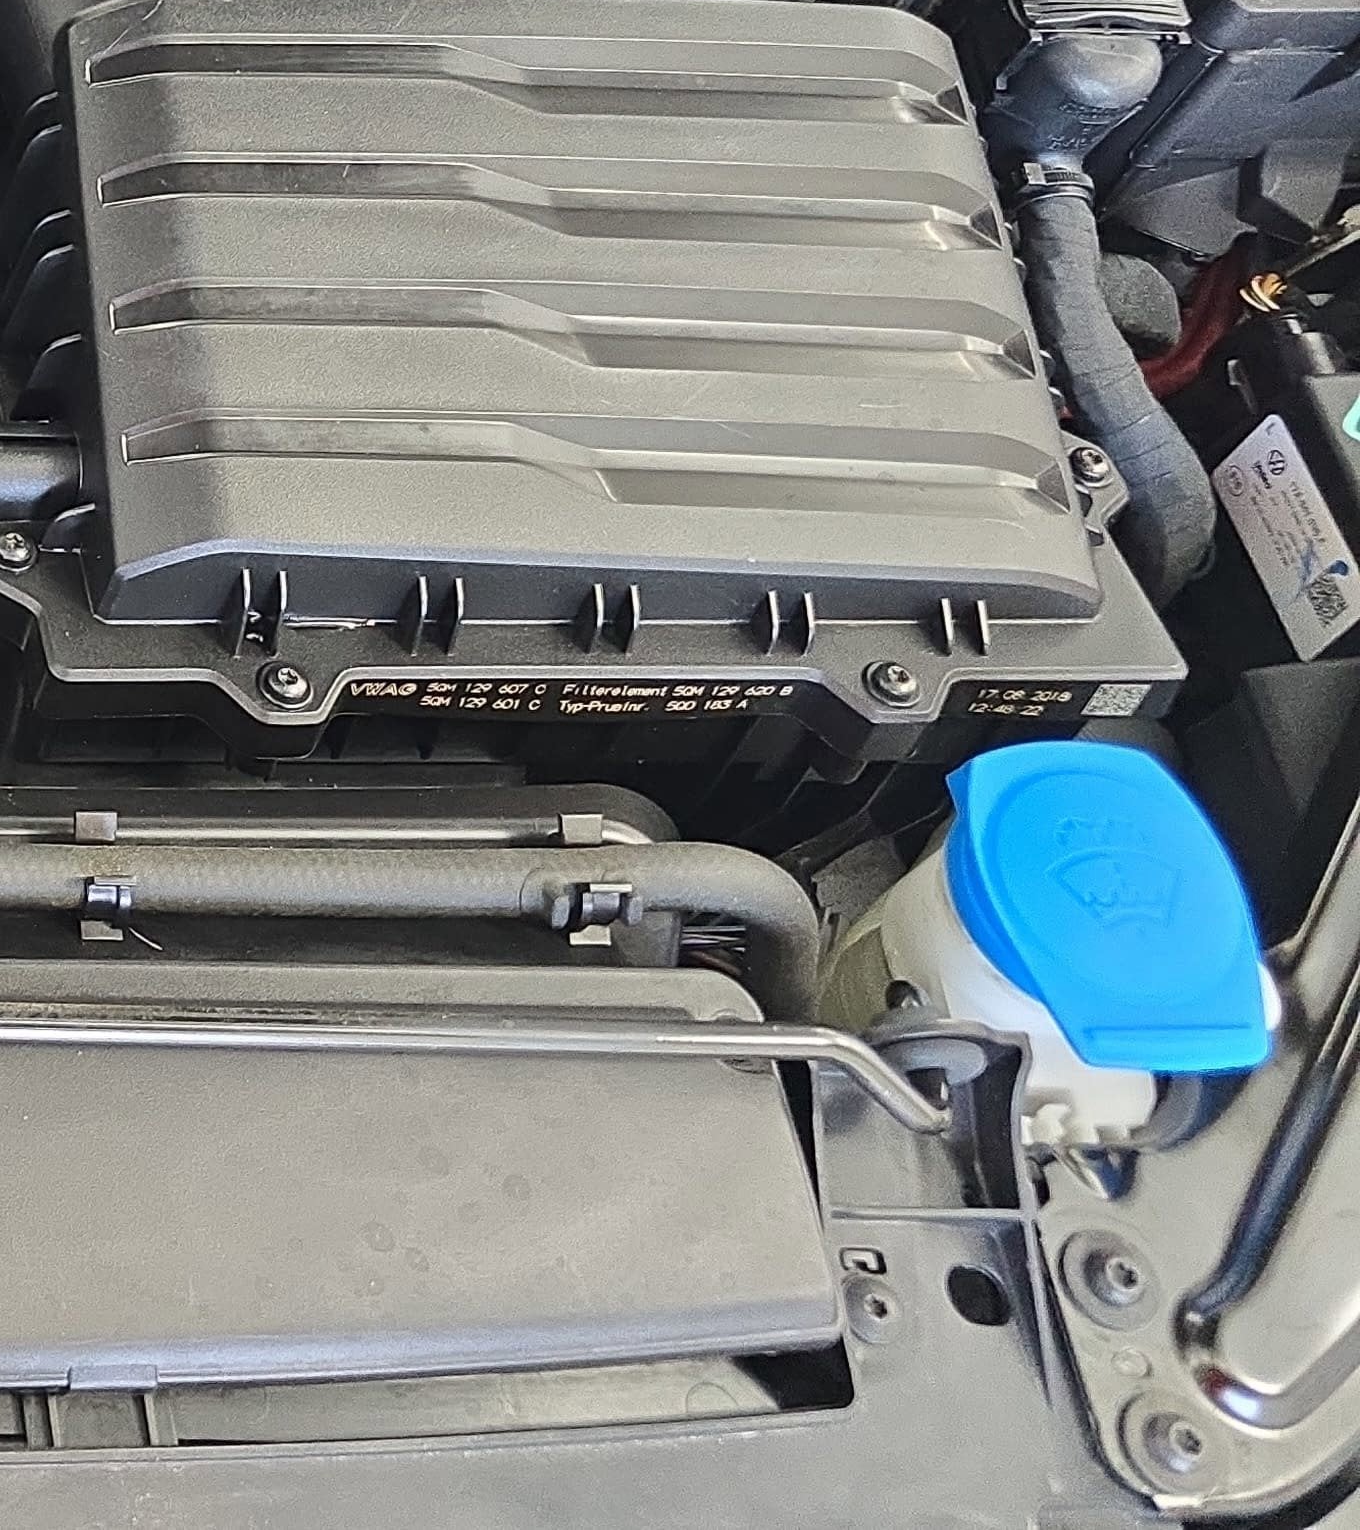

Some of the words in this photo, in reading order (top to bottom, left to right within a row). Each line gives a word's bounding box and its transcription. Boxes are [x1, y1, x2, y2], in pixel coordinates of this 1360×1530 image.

[426, 682, 457, 693] 5QM
[465, 683, 492, 694] 129
[498, 684, 528, 695] 607
[534, 684, 547, 695] C
[562, 684, 668, 697] Filterelement
[671, 686, 704, 697] 5QM
[712, 686, 740, 697] 129
[744, 686, 775, 697] 620
[779, 686, 794, 697] B
[1030, 690, 1073, 702] 2018
[419, 696, 451, 707] 5QM
[459, 697, 487, 708] 129
[492, 698, 520, 710] 601
[528, 699, 542, 710] C
[703, 701, 732, 711] 183
[736, 699, 749, 710] A
